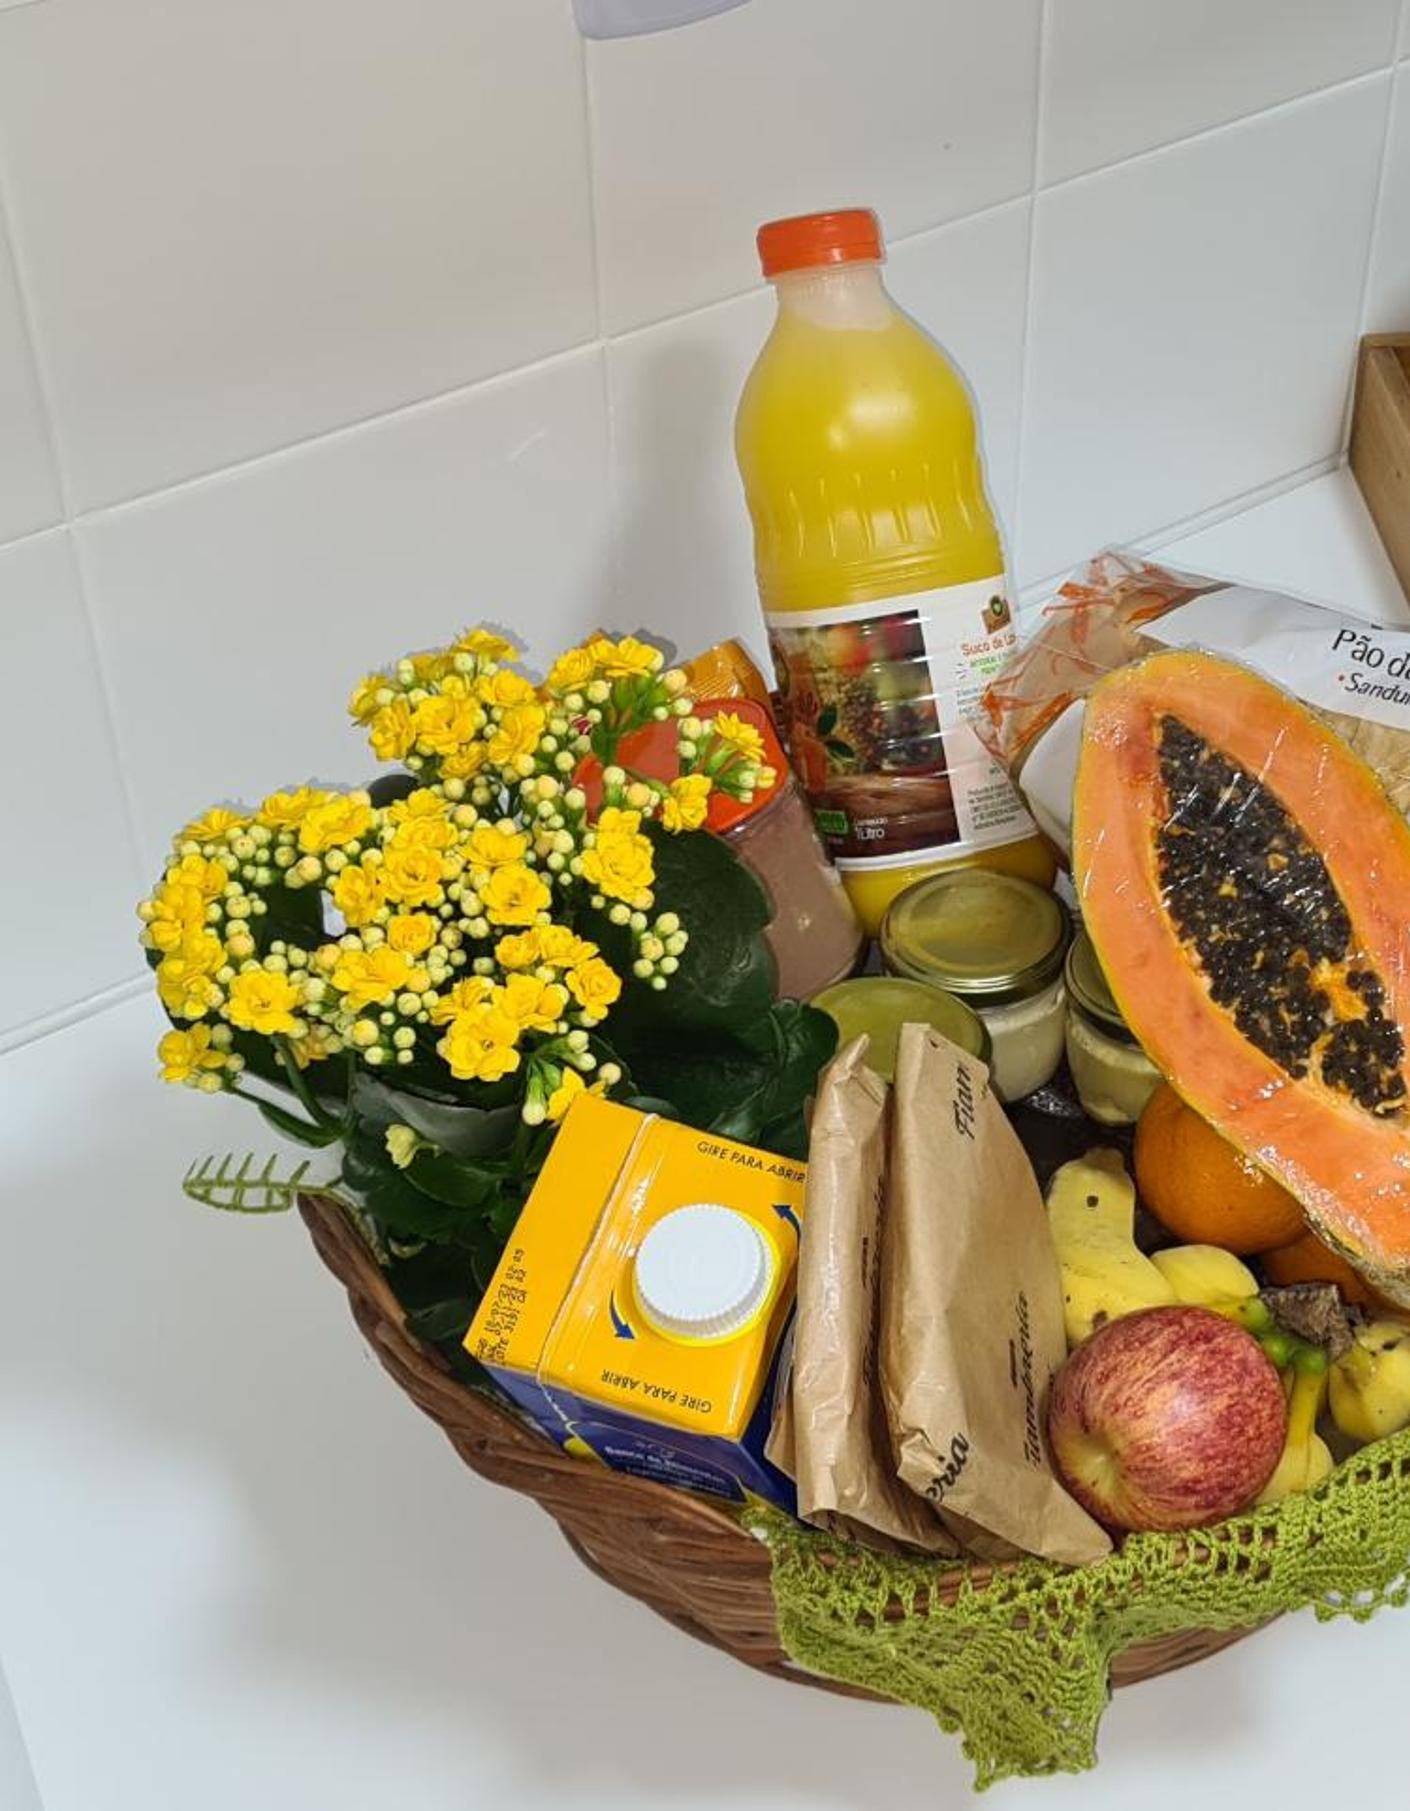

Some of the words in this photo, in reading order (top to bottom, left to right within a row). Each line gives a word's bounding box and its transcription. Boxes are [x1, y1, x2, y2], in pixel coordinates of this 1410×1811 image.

[961, 642, 991, 656] Suco
[992, 635, 1004, 650] de
[1332, 629, 1385, 668] Pão
[697, 1141, 729, 1160] GIRE
[731, 1151, 763, 1171] PARA
[766, 1163, 807, 1184] ABRIR
[601, 1369, 641, 1391] ABRIR
[643, 1381, 678, 1402] PARA
[680, 1394, 713, 1414] GIRE
